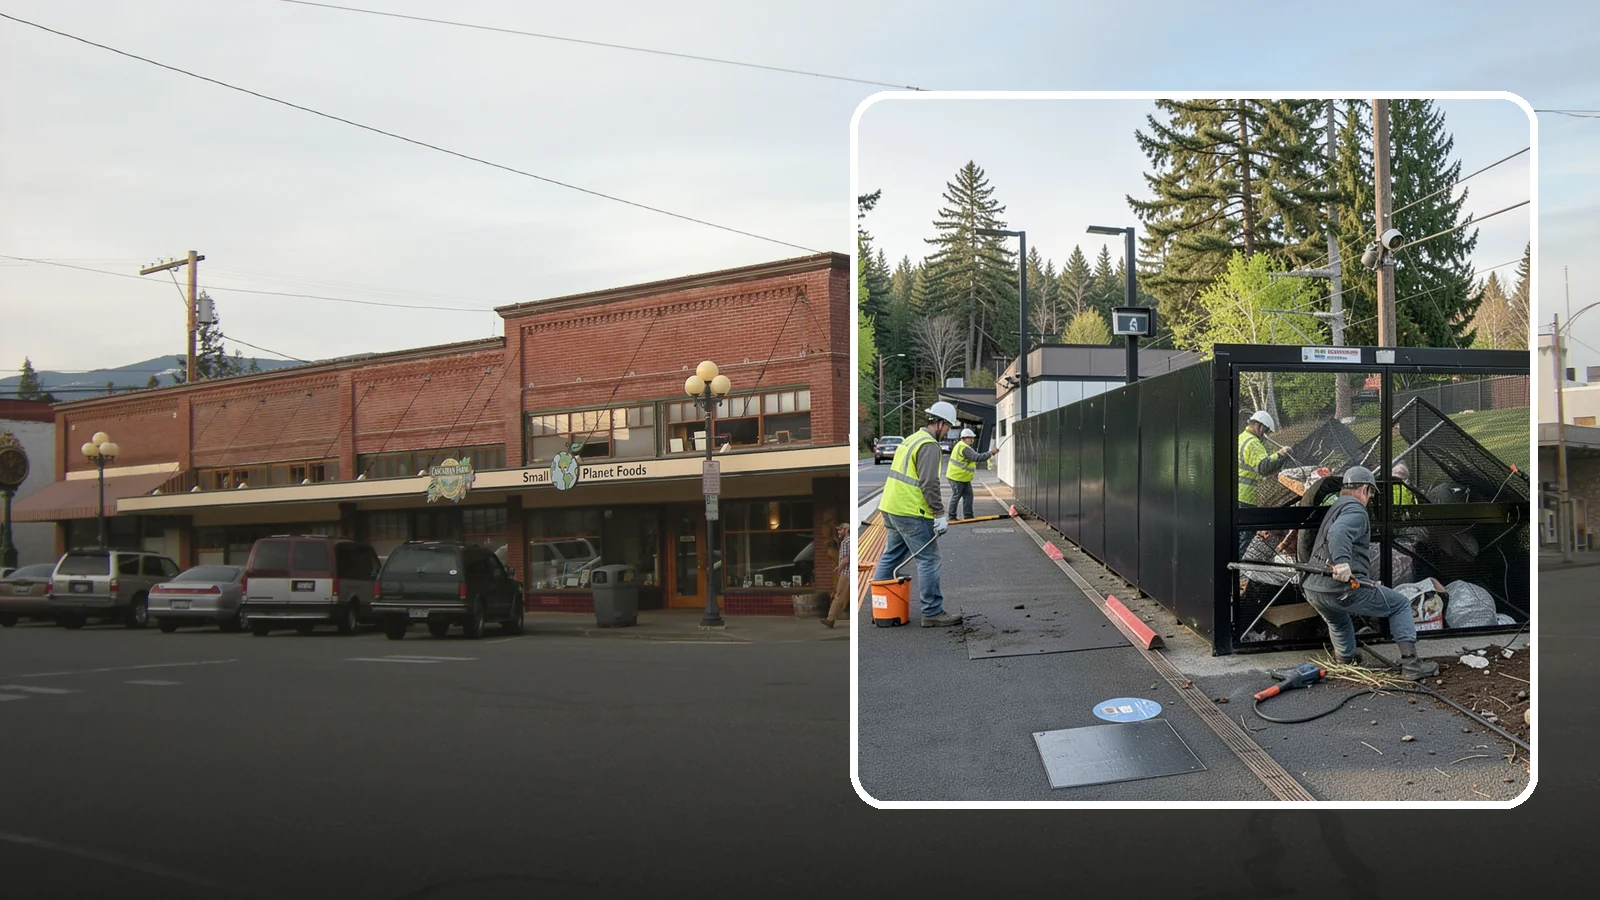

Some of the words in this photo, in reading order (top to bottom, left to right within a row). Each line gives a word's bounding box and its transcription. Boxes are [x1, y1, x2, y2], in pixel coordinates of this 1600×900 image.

[523, 471, 549, 483] Small
[583, 467, 614, 479] Planet
[616, 464, 647, 477] Foods
